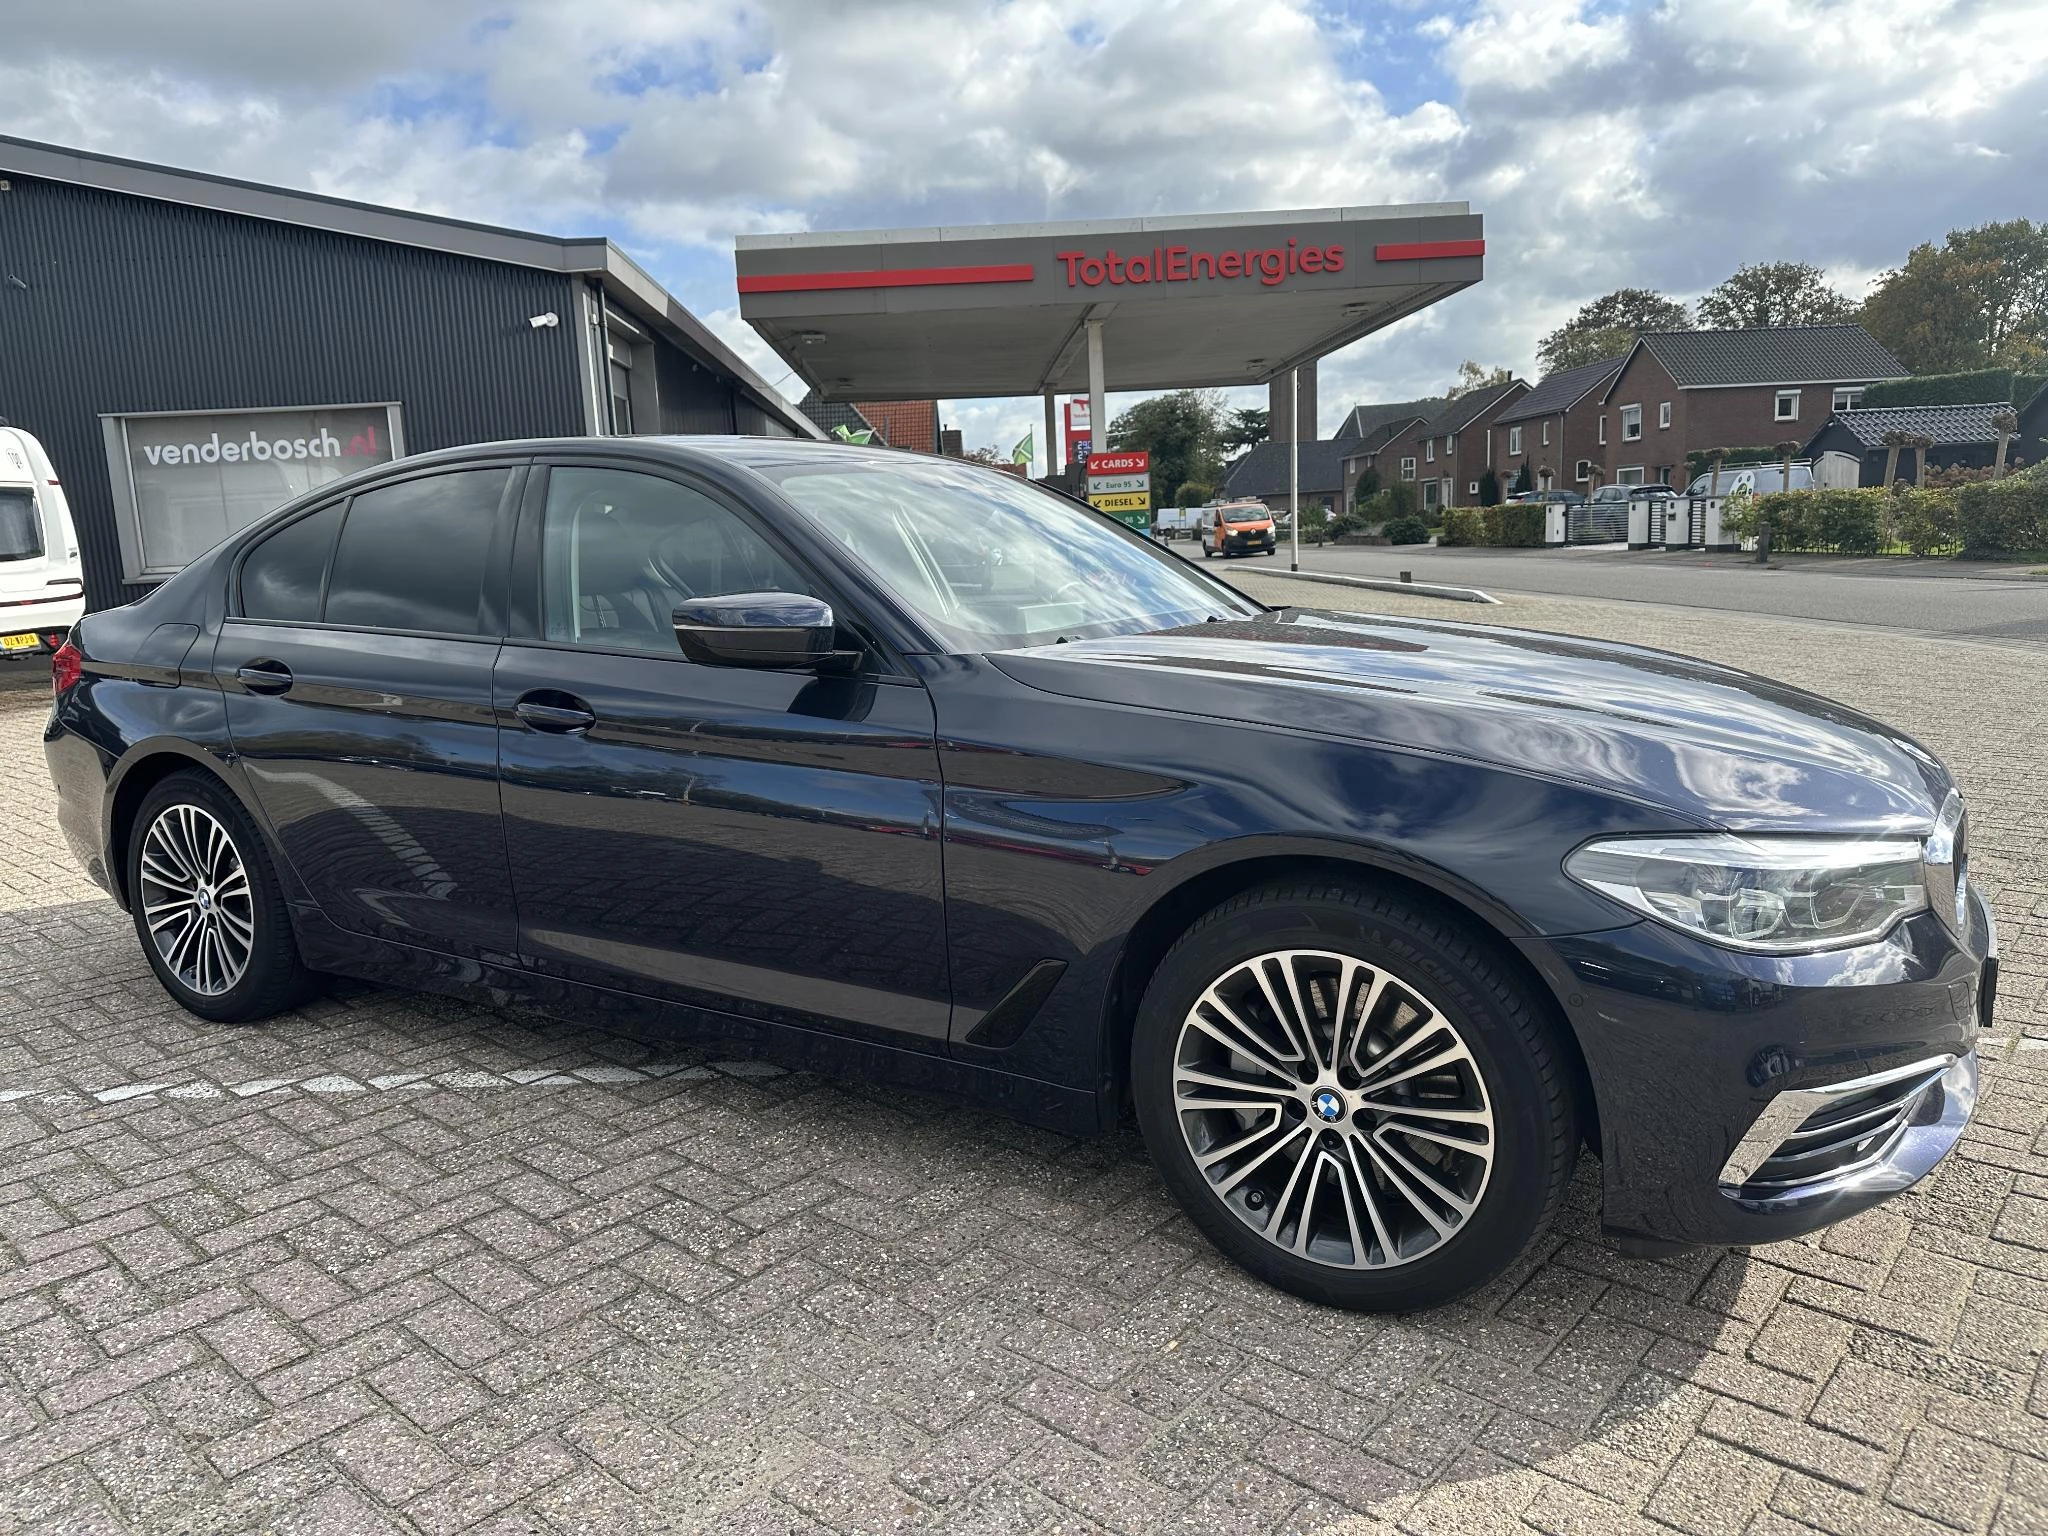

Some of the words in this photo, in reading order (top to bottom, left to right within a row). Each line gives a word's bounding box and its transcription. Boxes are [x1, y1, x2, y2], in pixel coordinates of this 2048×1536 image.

[1057, 237, 1345, 286] TotalEnergies
[143, 425, 377, 466] venderbosch.nl
[1101, 459, 1134, 469] CARDS
[1104, 498, 1134, 507] DIESEL
[1387, 938, 1497, 1032] MICHELIN
